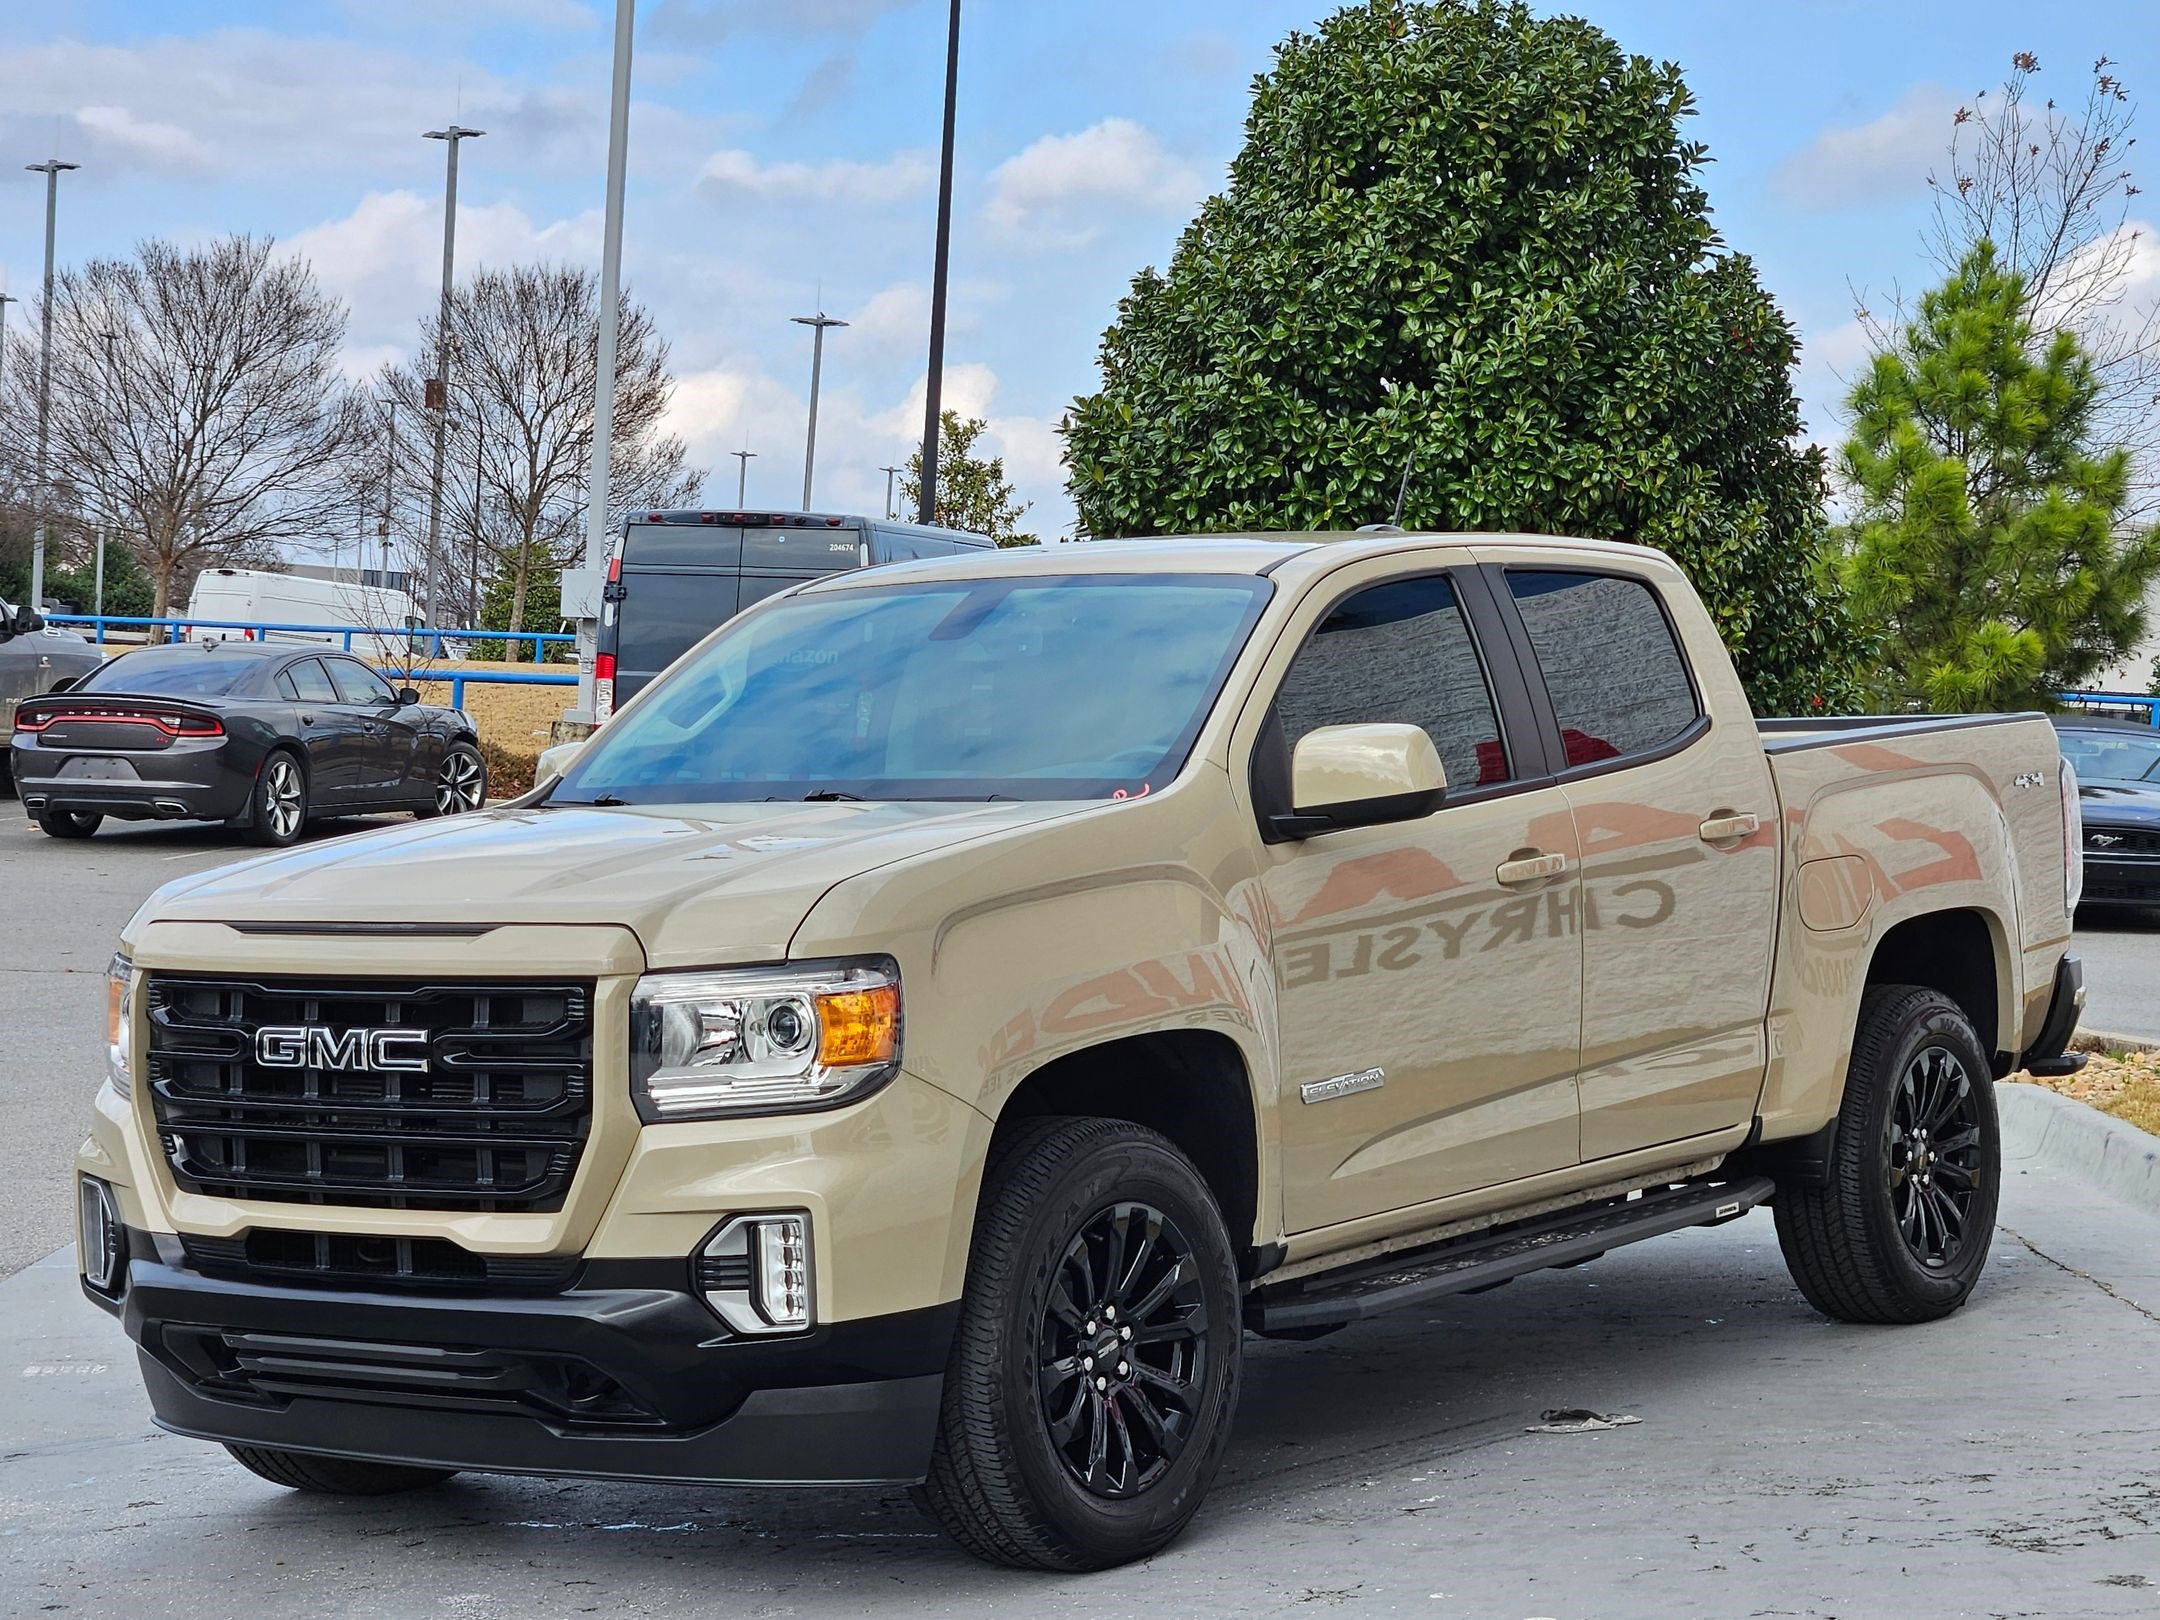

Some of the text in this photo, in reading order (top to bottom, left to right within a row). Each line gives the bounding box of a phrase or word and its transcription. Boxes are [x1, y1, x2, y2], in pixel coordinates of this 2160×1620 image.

[829, 543, 854, 552] 204674
[255, 1026, 430, 1073] GMC
[1309, 1072, 1380, 1097] ELEVATION
